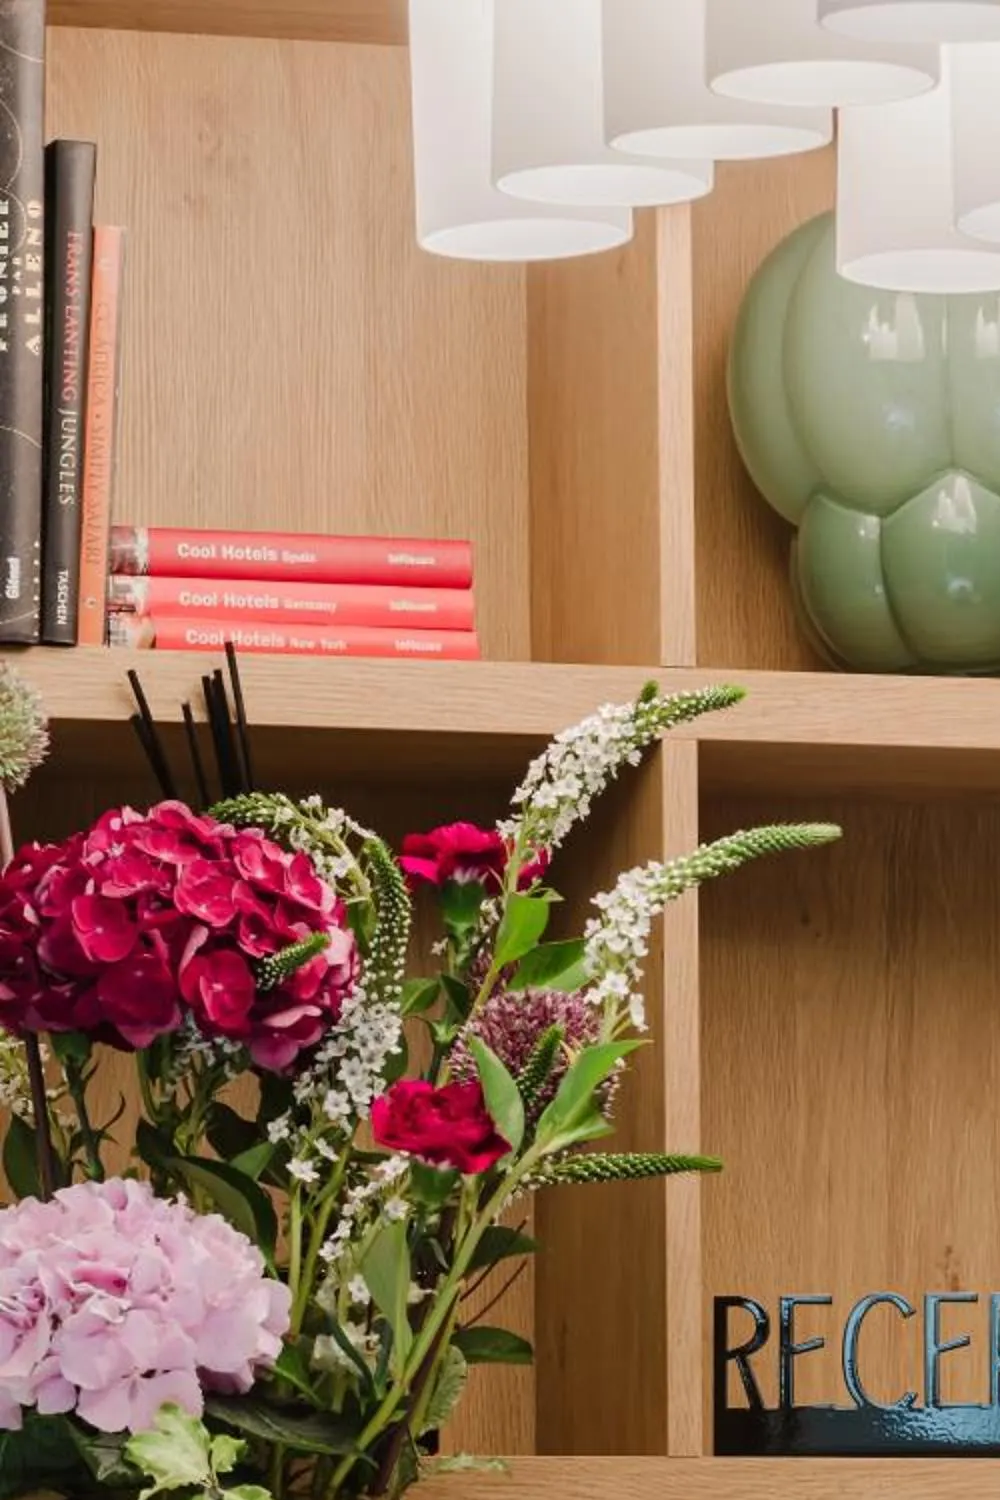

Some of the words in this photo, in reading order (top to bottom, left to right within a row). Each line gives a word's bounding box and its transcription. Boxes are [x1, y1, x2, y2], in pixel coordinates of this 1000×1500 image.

[24, 200, 42, 356] ALLENO
[65, 231, 83, 299] FRANS
[61, 305, 81, 402] LANTING
[58, 408, 79, 505] JUNGLES
[89, 425, 105, 495] SIMPLY
[85, 496, 102, 566] SAFARI
[177, 542, 216, 559] Cool
[221, 544, 278, 562] Hotels
[56, 569, 69, 626] TASCHEN
[178, 590, 219, 608] Cool
[223, 592, 279, 609] Hotels
[185, 628, 225, 645] Cool
[229, 630, 288, 648] Hotels
